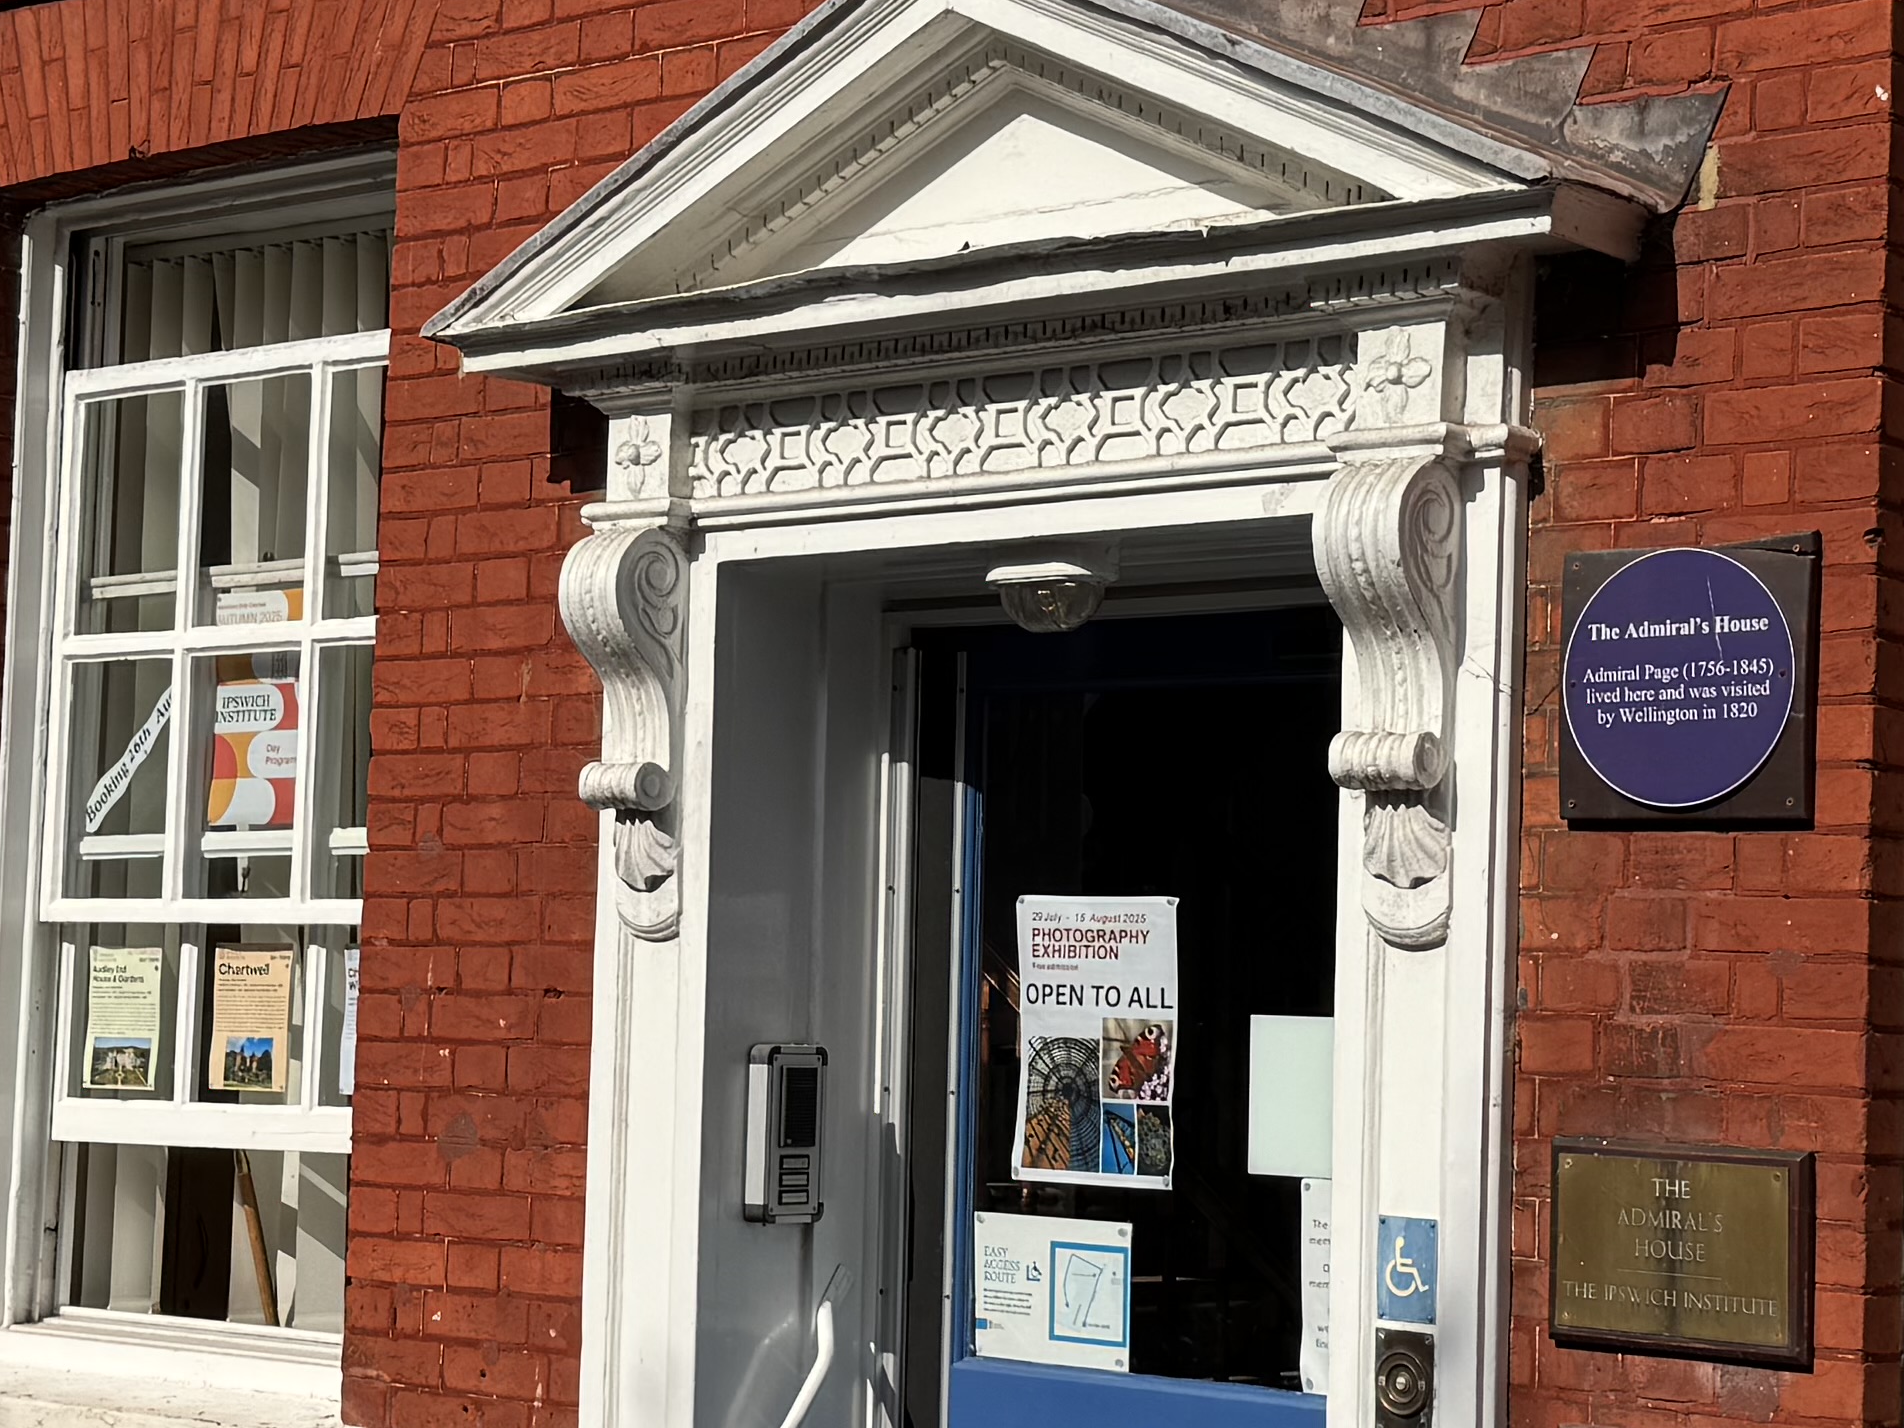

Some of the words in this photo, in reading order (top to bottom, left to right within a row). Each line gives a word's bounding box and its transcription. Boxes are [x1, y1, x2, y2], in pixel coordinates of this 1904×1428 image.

[1588, 623, 1620, 642] The
[1624, 617, 1711, 640] Admiral's
[1714, 615, 1770, 634] House
[1583, 663, 1640, 684] Admiral
[1644, 663, 1680, 684] Page
[1682, 657, 1775, 682] (1756-1845)
[222, 694, 271, 709] IPSWICH
[1586, 688, 1622, 705] lived
[1624, 684, 1655, 703] here
[1658, 684, 1686, 701] and
[1689, 684, 1718, 699] was
[1720, 679, 1771, 698] visited
[215, 708, 277, 723] INSTITUTE
[1597, 708, 1617, 728] by
[1619, 705, 1698, 726] Wellington
[1702, 703, 1717, 720] in
[1722, 702, 1758, 719] 1820
[266, 743, 280, 756] Day
[84, 762, 130, 824] Booking
[1044, 912, 1062, 924] July
[1089, 913, 1121, 925] August
[1032, 927, 1150, 945] PHOTOGRAPHY
[1032, 943, 1119, 960] EXHIBITION
[1026, 983, 1085, 1007] OPEN
[1091, 985, 1122, 1008] TO
[1128, 986, 1175, 1010] ALL
[1650, 1178, 1692, 1199] THE
[1617, 1208, 1725, 1233] ADMIRAL'S
[984, 1246, 1008, 1257] EASY
[1634, 1238, 1707, 1262] HOUSE
[984, 1259, 1020, 1271] ACCESS
[984, 1271, 1016, 1284] ROUTE
[1563, 1280, 1597, 1299] THE
[1604, 1284, 1678, 1308] IPSWICH
[1684, 1291, 1778, 1317] INSTITUTE
